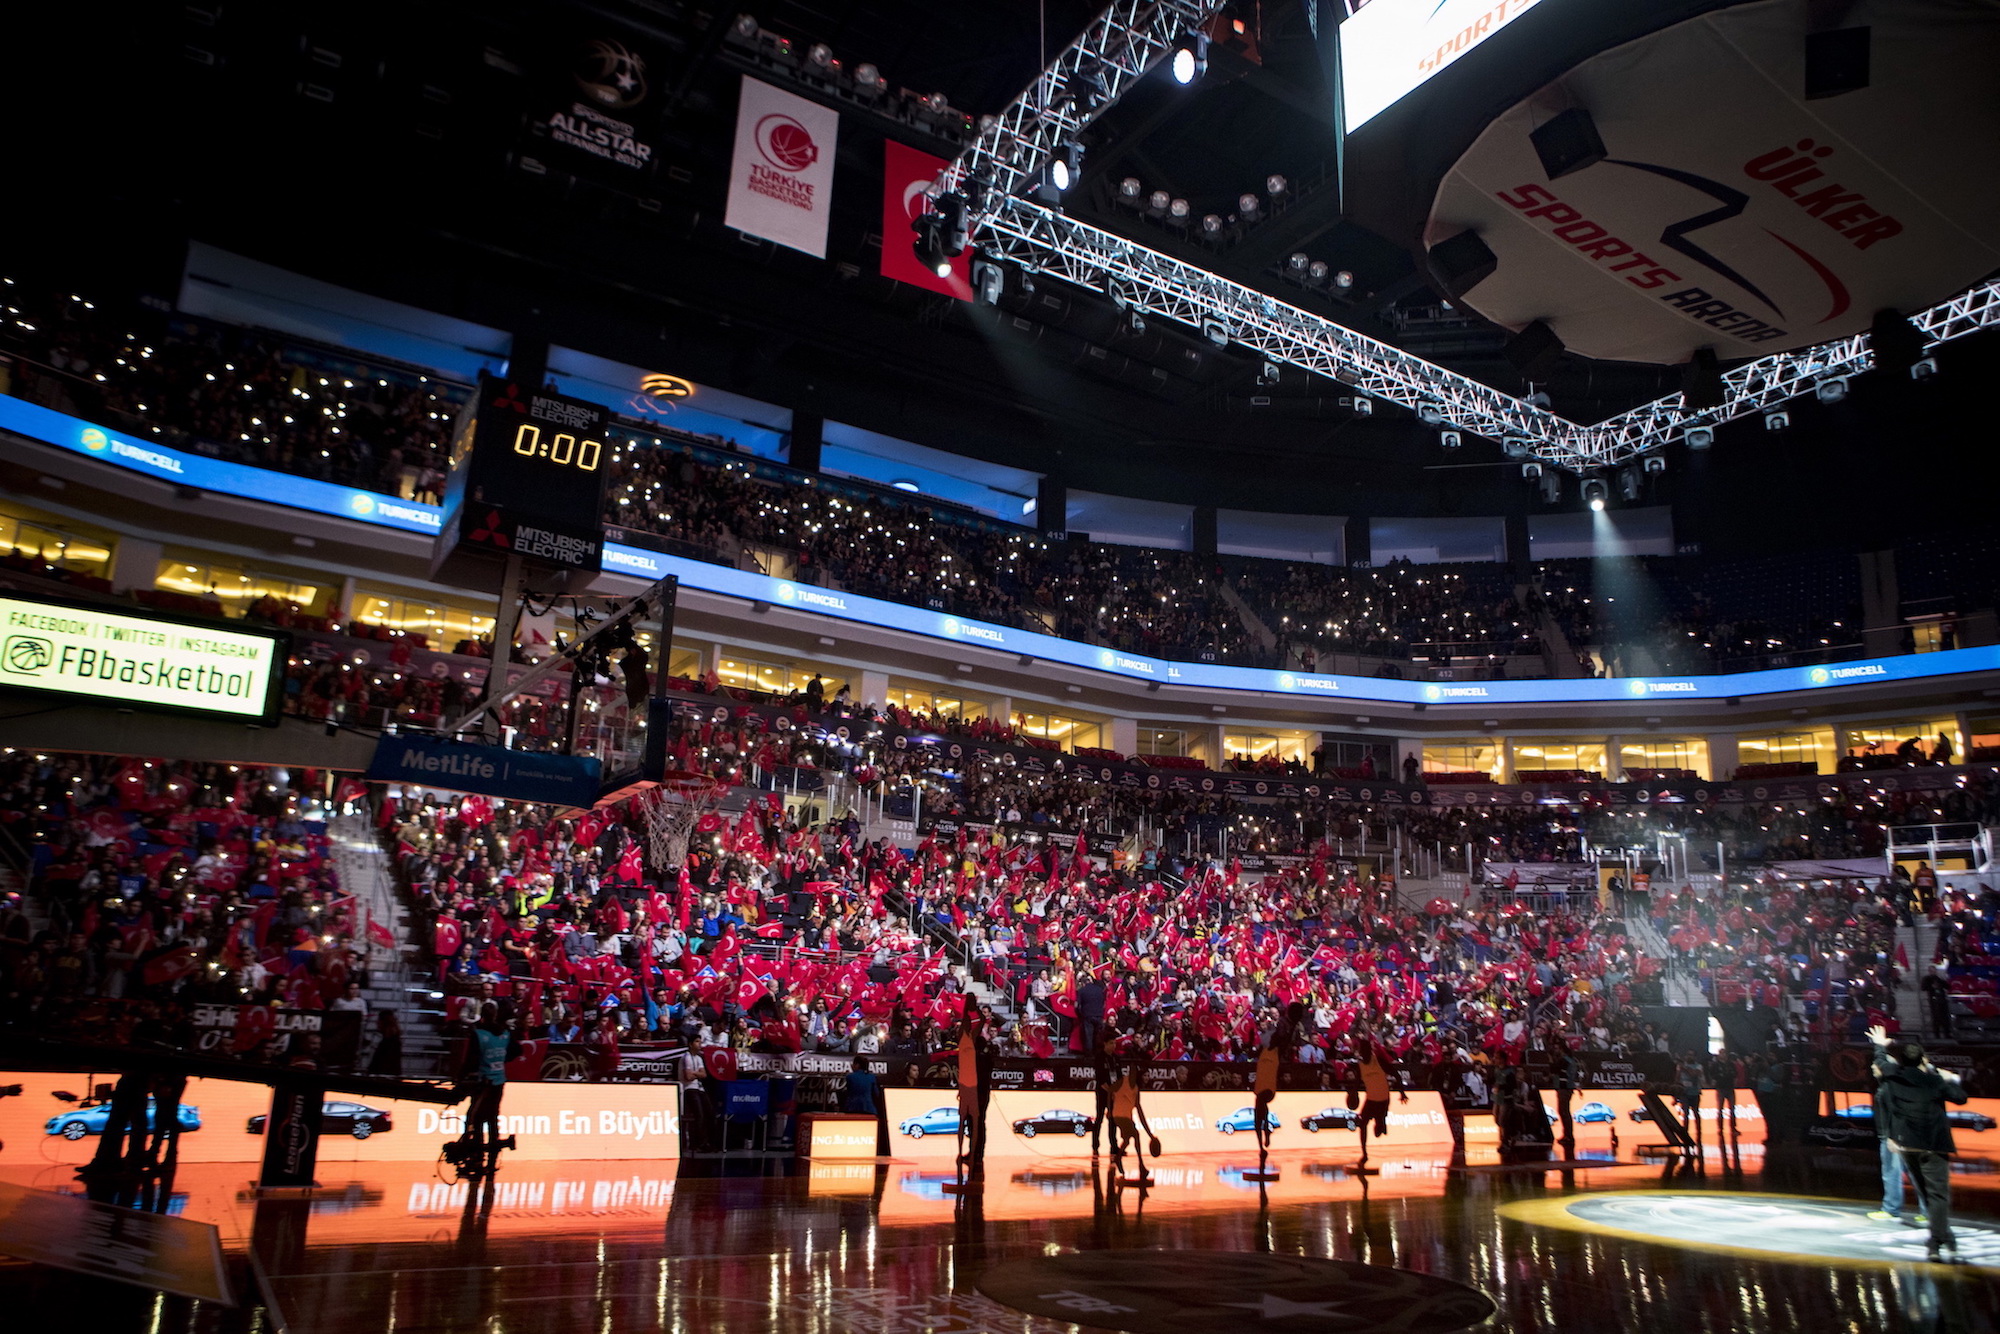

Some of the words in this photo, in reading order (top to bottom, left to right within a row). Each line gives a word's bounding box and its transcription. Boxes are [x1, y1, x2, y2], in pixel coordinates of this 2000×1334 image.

[749, 174, 813, 205] BASKETBOL
[751, 163, 815, 196] TÜRKİYE
[1743, 138, 1903, 250] ÜLKER
[1497, 183, 1681, 290] SPORTS
[530, 406, 589, 431] ELECTRIC
[531, 396, 600, 421] MITSUBISHI
[110, 439, 184, 475] TURKCELL
[514, 424, 602, 471] 0:00
[377, 502, 441, 527] TURKCELL
[515, 524, 596, 555] MITSUBISHI
[605, 529, 624, 540] 415
[514, 539, 584, 565] ELECTRIC
[602, 549, 658, 571] TURKCELL
[797, 590, 847, 611] TURKCELL
[928, 599, 944, 610] 414
[9, 611, 89, 637] FACEBOOK
[104, 625, 166, 648] TWITTER
[178, 637, 259, 661] INSTAGRAM
[961, 623, 1005, 643] TURKCELL
[1116, 656, 1154, 674] TURKCELL
[1201, 652, 1215, 661] 413
[58, 645, 254, 698] FBbasketbol
[1438, 669, 1453, 678] 412
[1831, 664, 1886, 680] TURKCELL
[1296, 677, 1339, 691] TURKCELL
[1443, 686, 1488, 697] TURKCELL
[1648, 682, 1698, 692] TURKCELL
[400, 748, 496, 779] MetLife
[617, 1062, 674, 1074] SPORTOTO
[732, 1095, 761, 1103] molten
[559, 1110, 590, 1135] En
[599, 1109, 680, 1141] Büyük
[1186, 1113, 1204, 1129] En
[810, 1135, 832, 1145] ING
[847, 1135, 875, 1145] BANK
